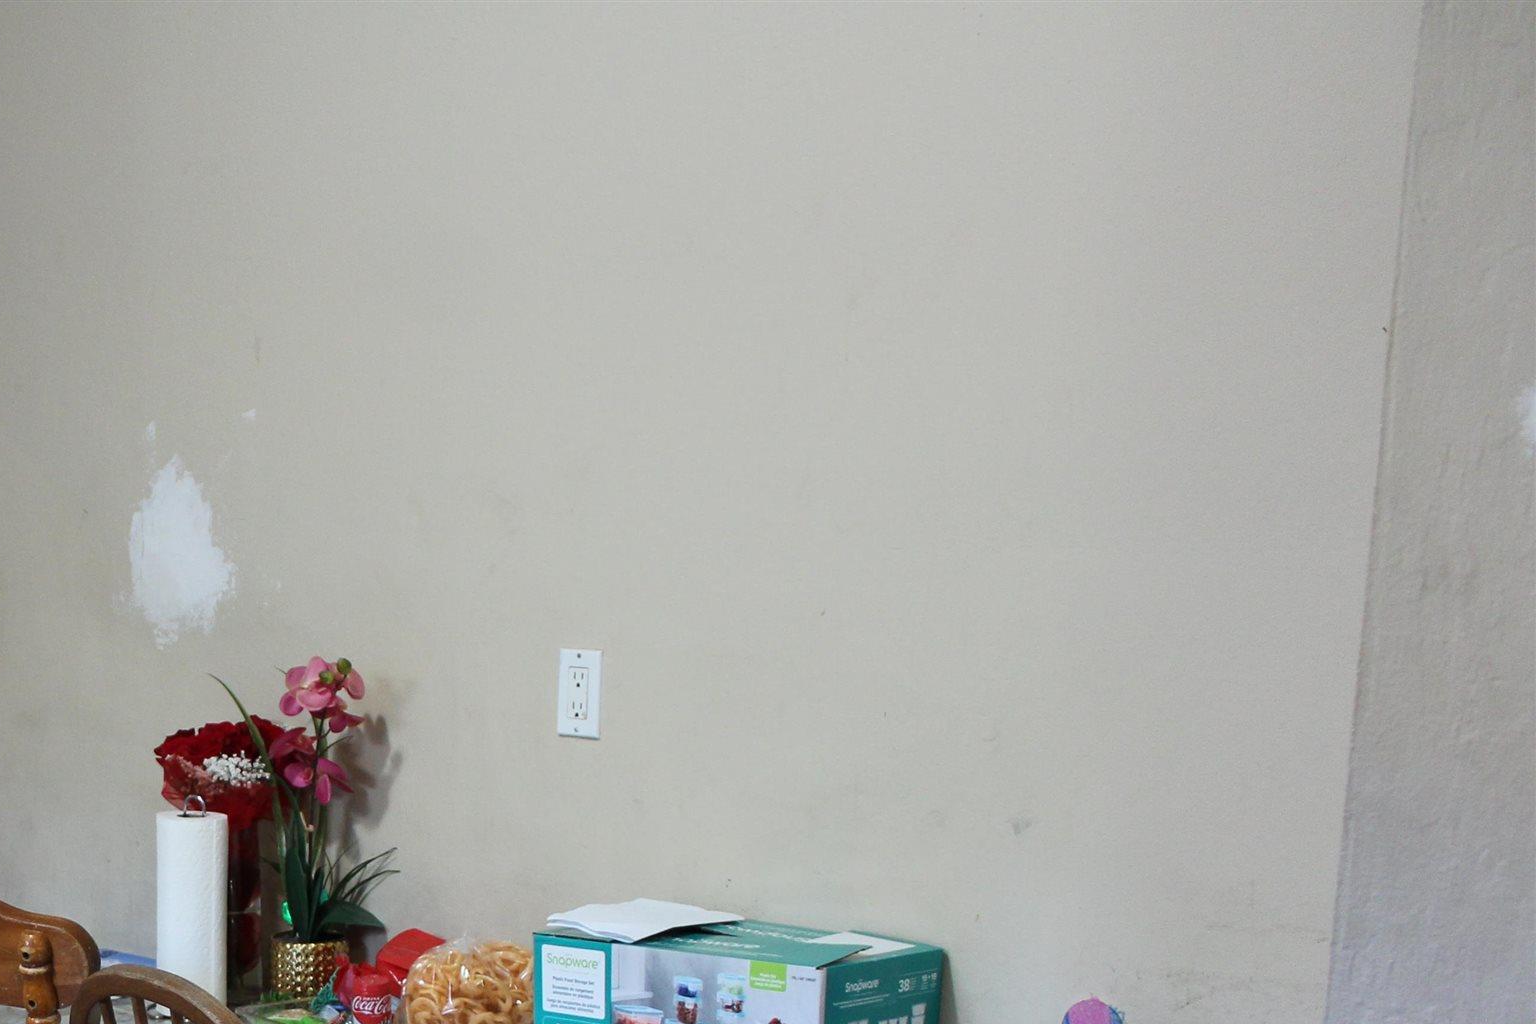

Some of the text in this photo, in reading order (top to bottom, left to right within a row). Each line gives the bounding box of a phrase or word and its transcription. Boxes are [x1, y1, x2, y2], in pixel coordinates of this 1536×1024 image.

[546, 953, 599, 969] Snapware
[898, 978, 910, 993] 38
[352, 995, 391, 1015] Coca-Co
